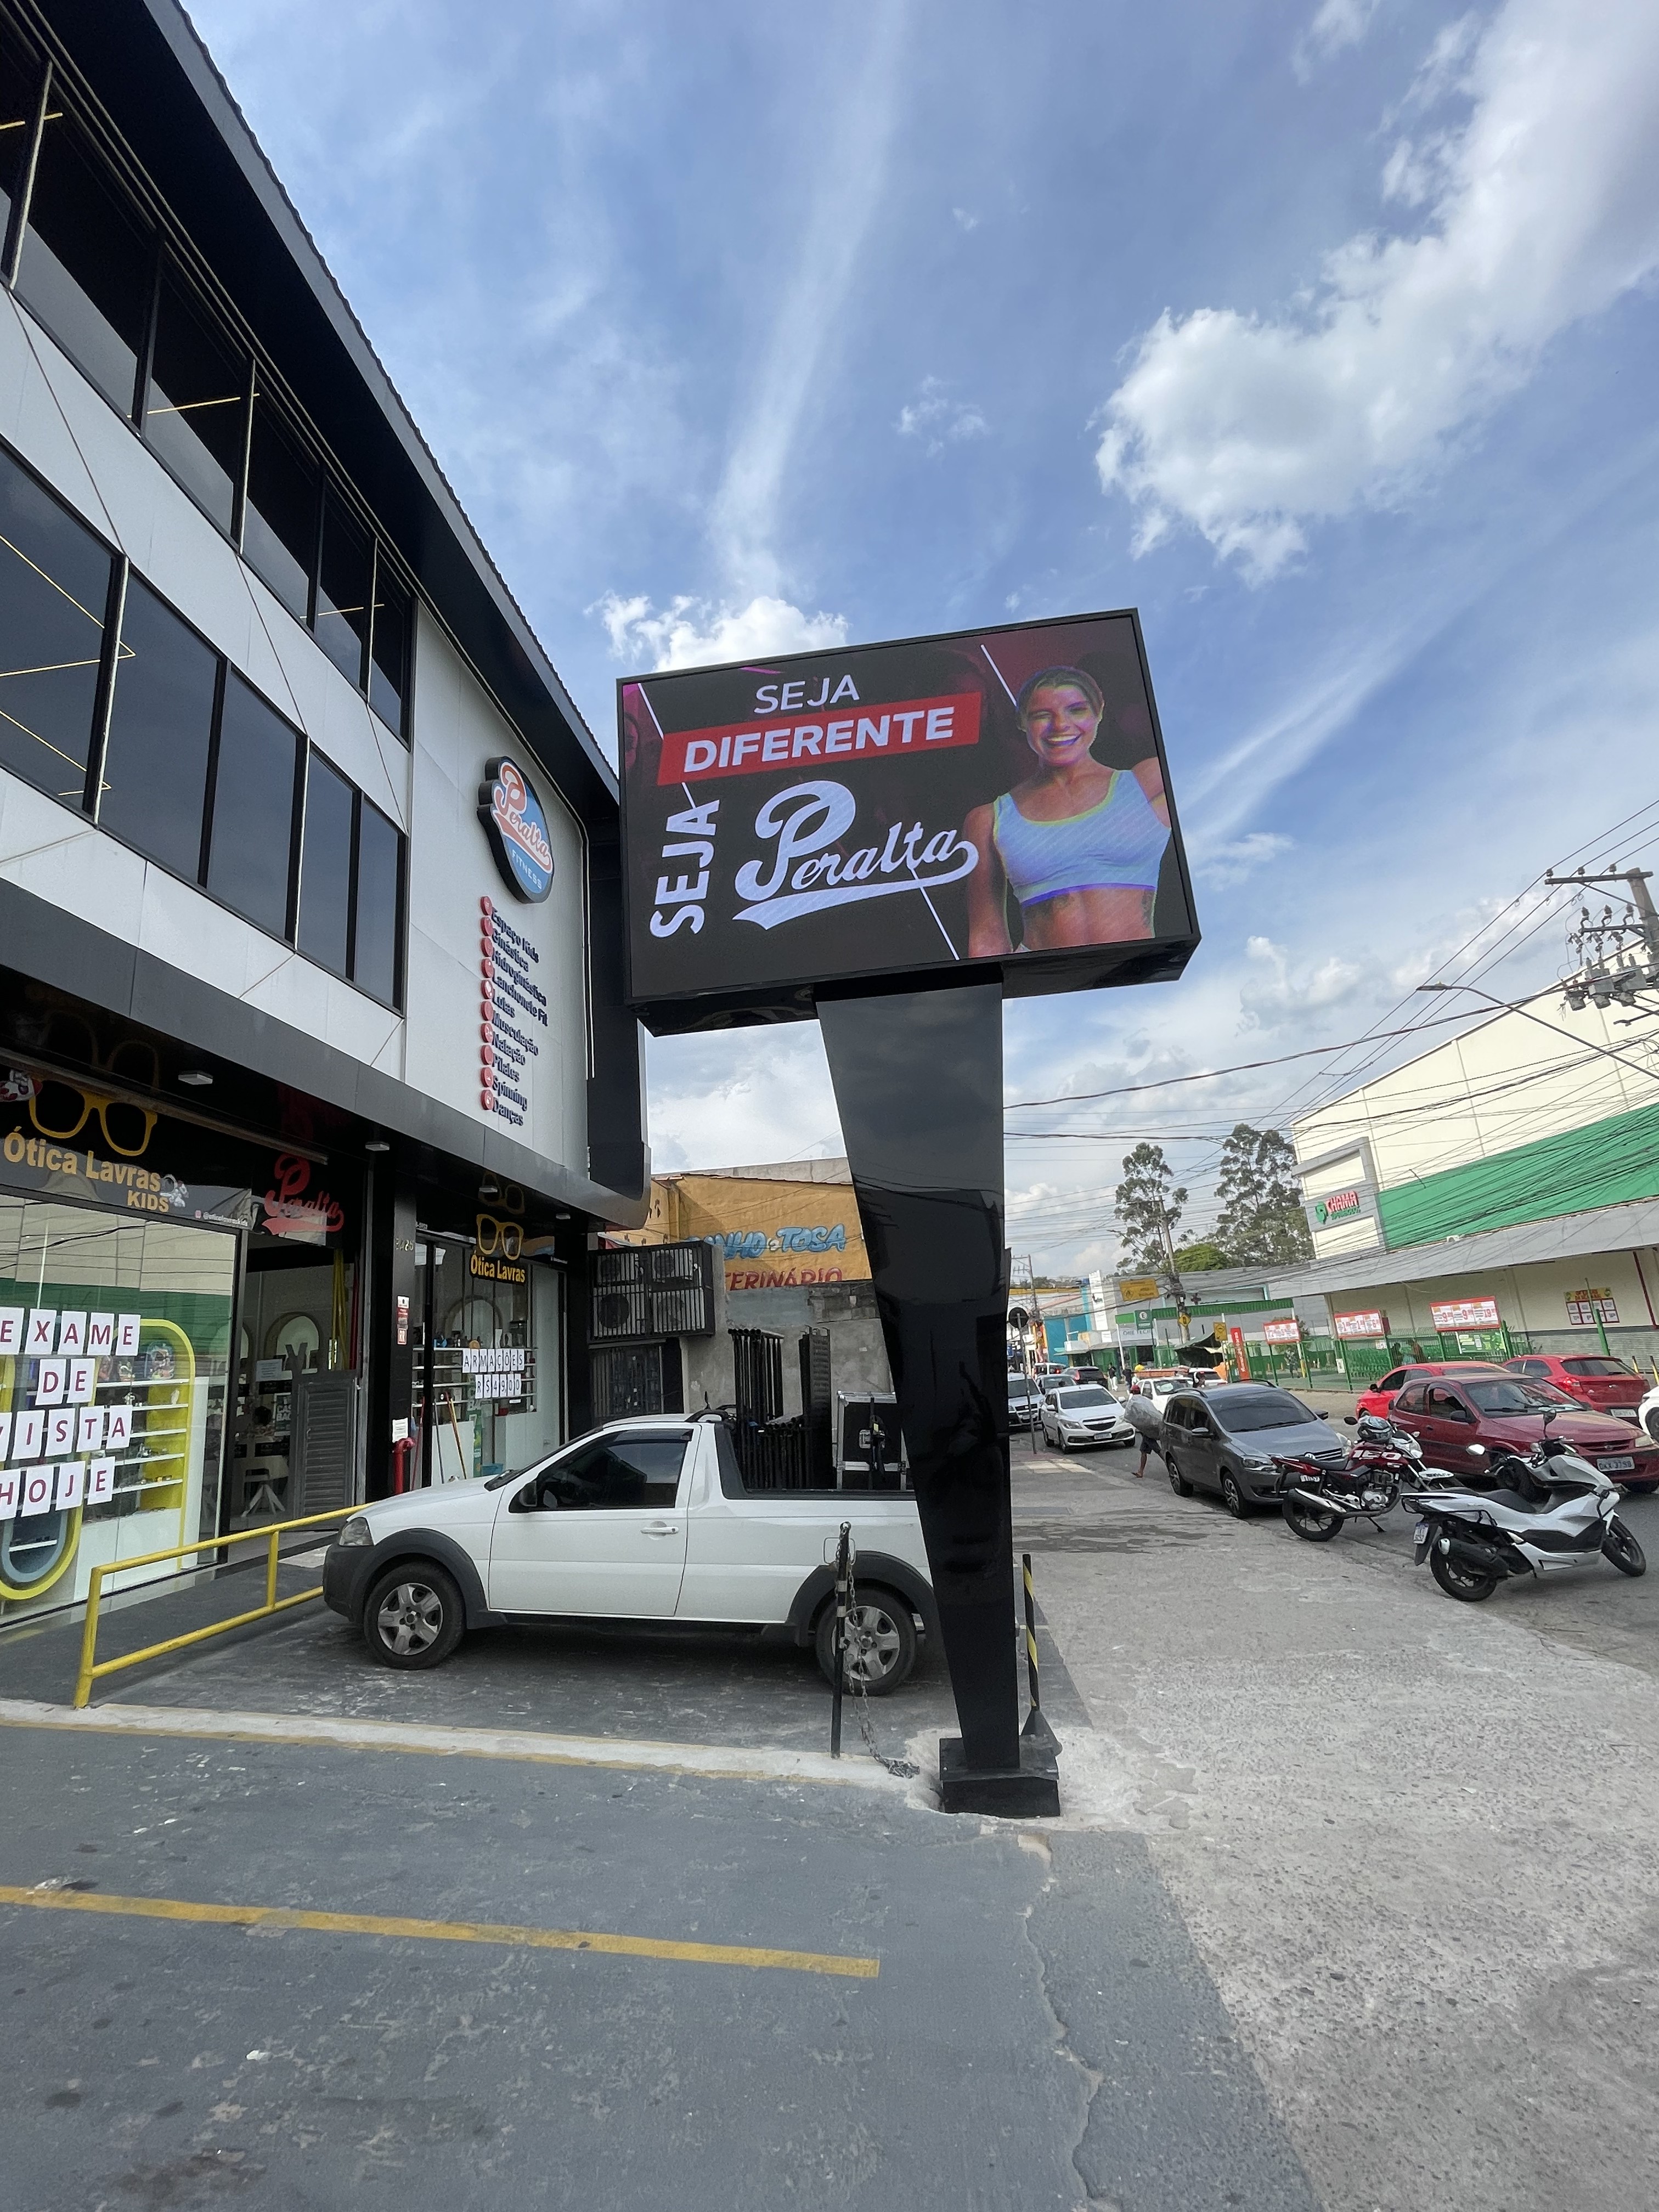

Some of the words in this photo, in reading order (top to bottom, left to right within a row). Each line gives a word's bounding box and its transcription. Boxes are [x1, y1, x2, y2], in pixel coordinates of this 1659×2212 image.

[753, 674, 860, 714] SEJA
[683, 706, 955, 773] DIFERENTE
[494, 763, 551, 860] Peralta
[735, 780, 979, 908] Peralta
[511, 849, 543, 889] FITNESS
[650, 799, 720, 938] SEJA
[492, 906, 521, 946] Espaço
[522, 937, 539, 963] Kids
[492, 927, 529, 972] Ginástica
[492, 946, 547, 1007] Hidroginástica
[492, 967, 537, 1017] Lanchonete
[538, 1008, 548, 1026] Fit
[492, 988, 516, 1018] Lutas
[492, 1009, 539, 1056] Musculação
[492, 1031, 526, 1066] Natação
[492, 1052, 520, 1082] Pilates
[492, 1075, 528, 1111] Spinning
[492, 1097, 524, 1126] Danças
[4, 1126, 78, 1175] Ótica
[86, 1150, 161, 1192] Lavras
[127, 1189, 170, 1212] KIDS
[1325, 1190, 1359, 1213] CHAMA
[776, 1223, 846, 1253] TOSA
[471, 1249, 495, 1277] Ótica
[497, 1260, 526, 1283] Lavras
[1, 1320, 133, 1345] EXAME
[464, 1352, 523, 1369] ARMAÇÕES
[43, 1370, 87, 1393] DE
[0, 1470, 107, 1505] HOJE
